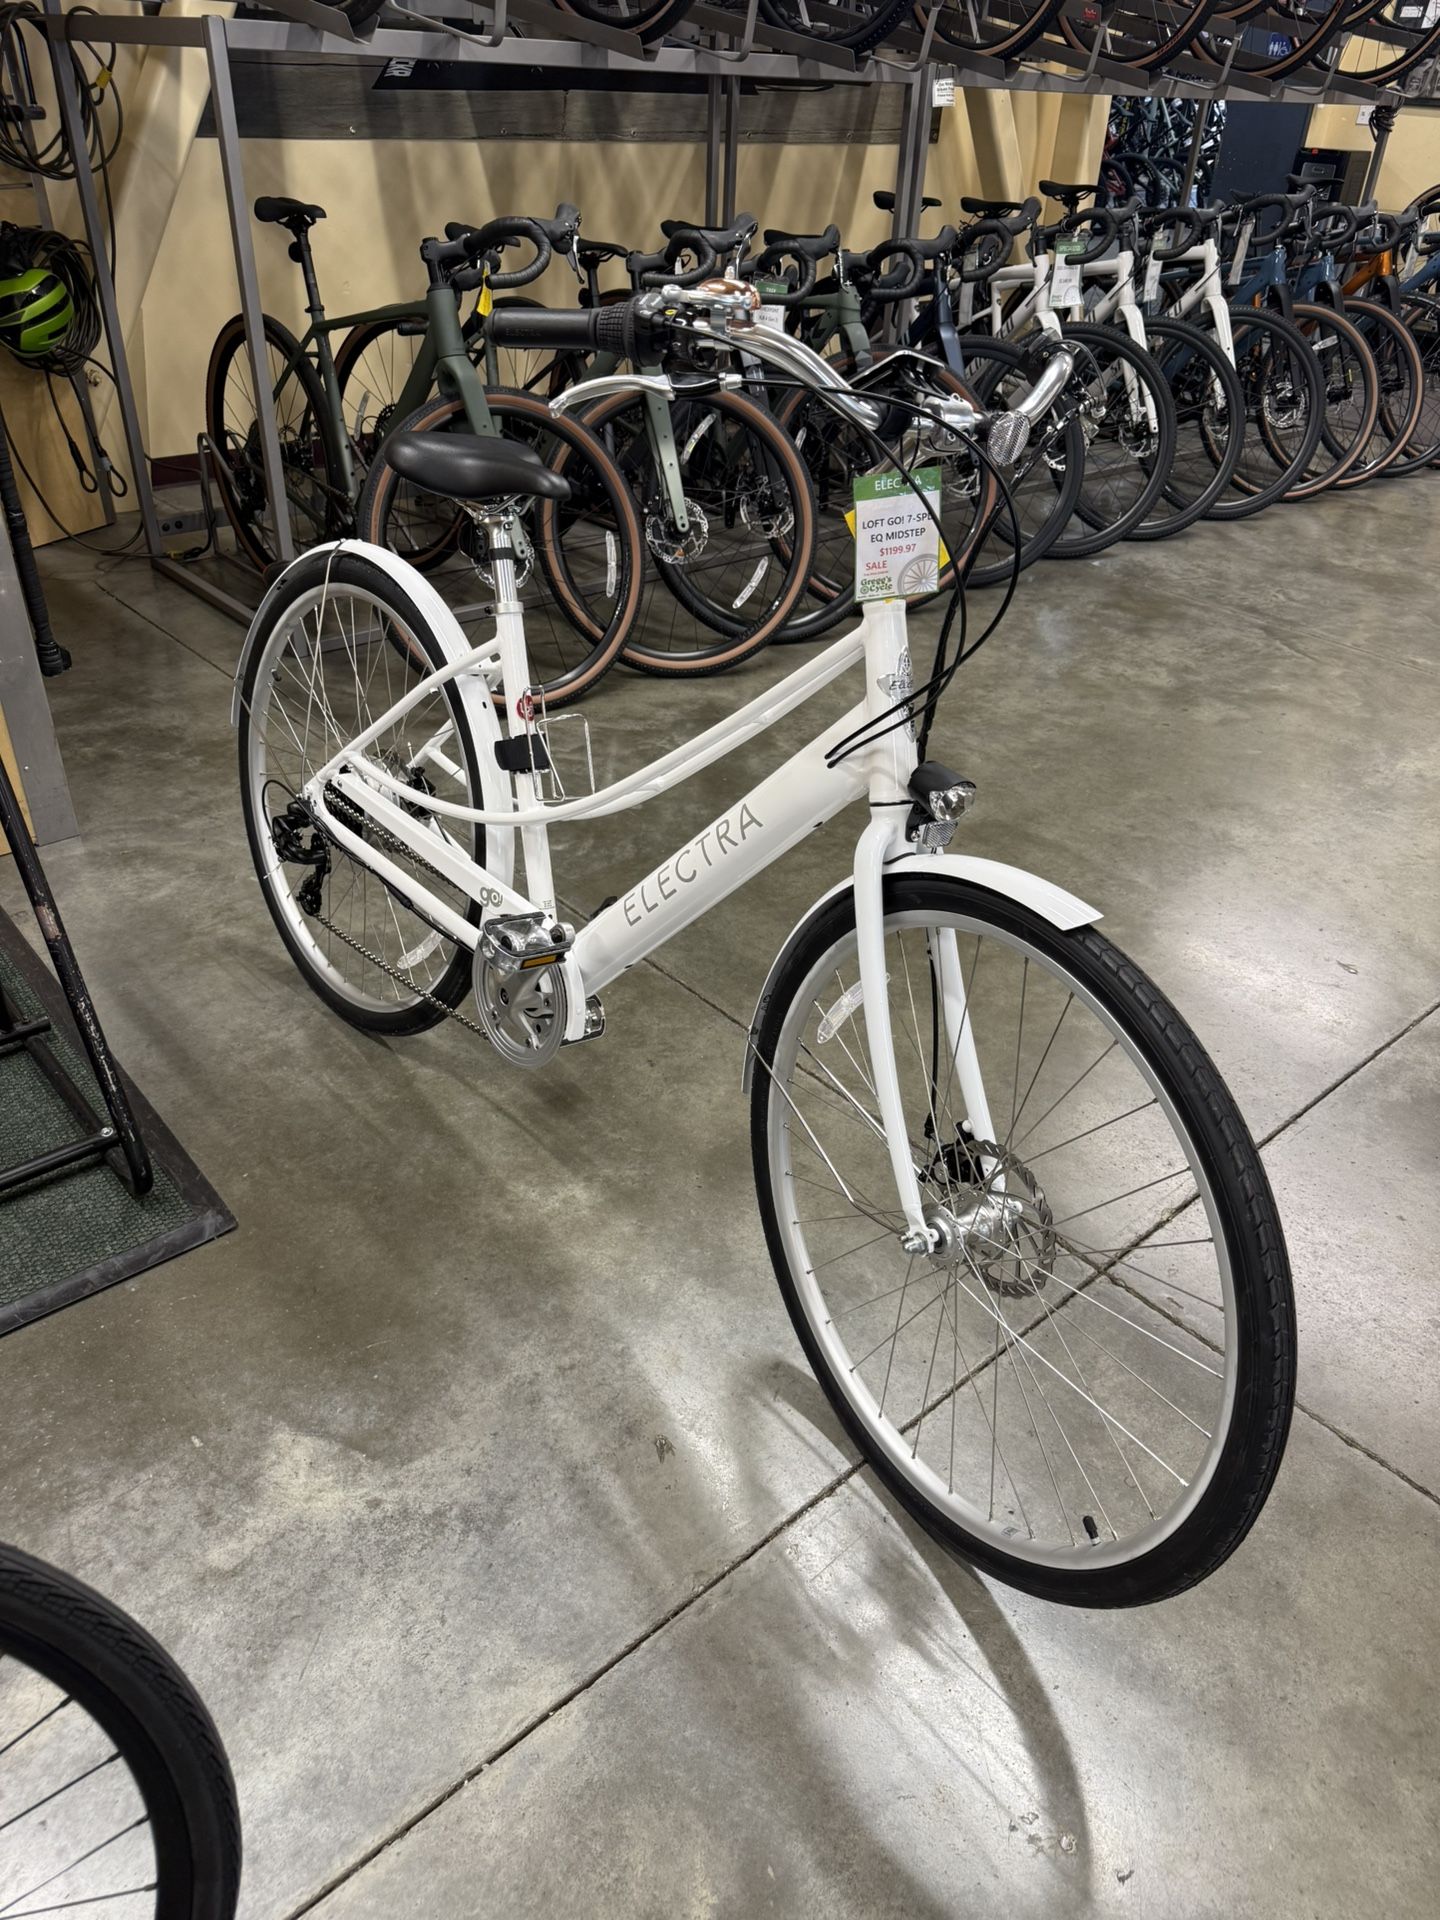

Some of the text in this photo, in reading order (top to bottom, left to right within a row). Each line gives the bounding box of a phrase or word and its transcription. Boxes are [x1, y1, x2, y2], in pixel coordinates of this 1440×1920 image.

[875, 475, 922, 491] ELECA
[862, 517, 885, 530] LOFT
[887, 515, 905, 527] GO!
[870, 527, 926, 544] EQ MIDSTEP
[879, 543, 917, 557] $1199.97
[865, 560, 888, 571] SALE
[860, 575, 892, 587] Gregg's
[868, 582, 893, 593] Cycle
[622, 802, 763, 927] ELECTRA
